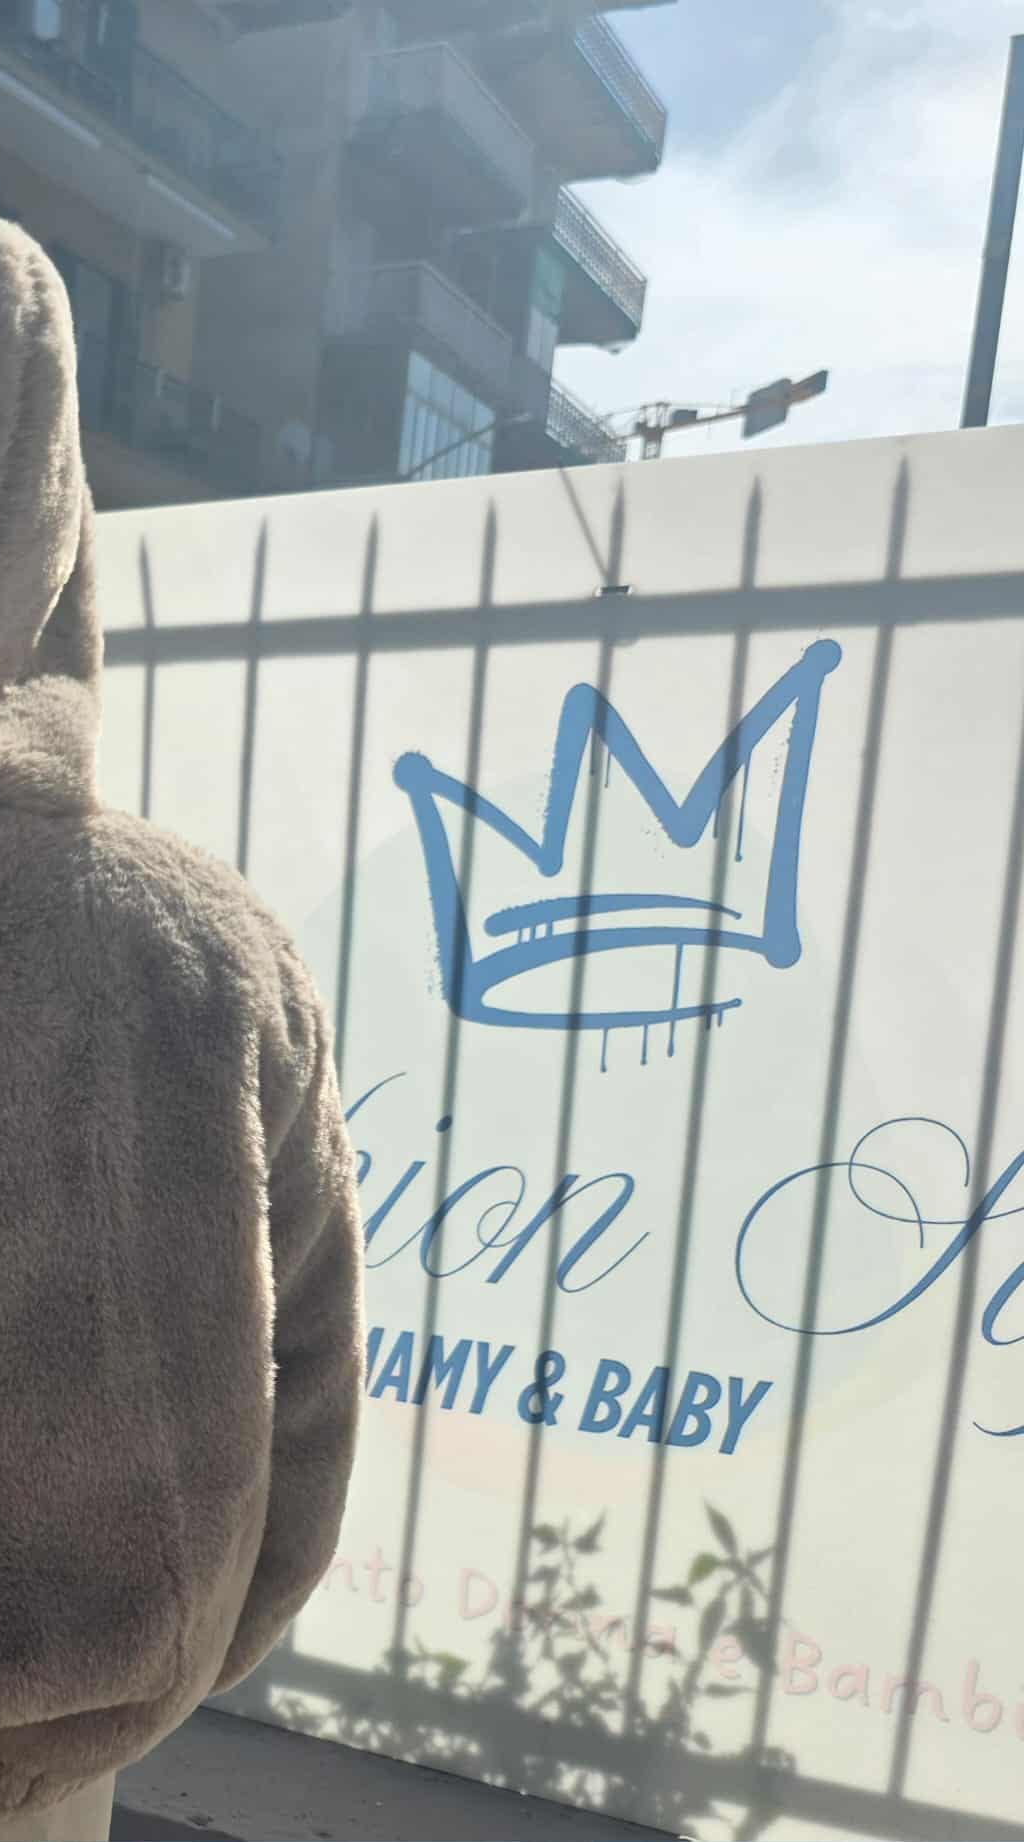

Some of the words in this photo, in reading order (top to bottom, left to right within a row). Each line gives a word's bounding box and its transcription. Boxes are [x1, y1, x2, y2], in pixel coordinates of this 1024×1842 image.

[344, 1071, 650, 1293] ion
[517, 1350, 567, 1426] &
[578, 1358, 774, 1455] BABY
